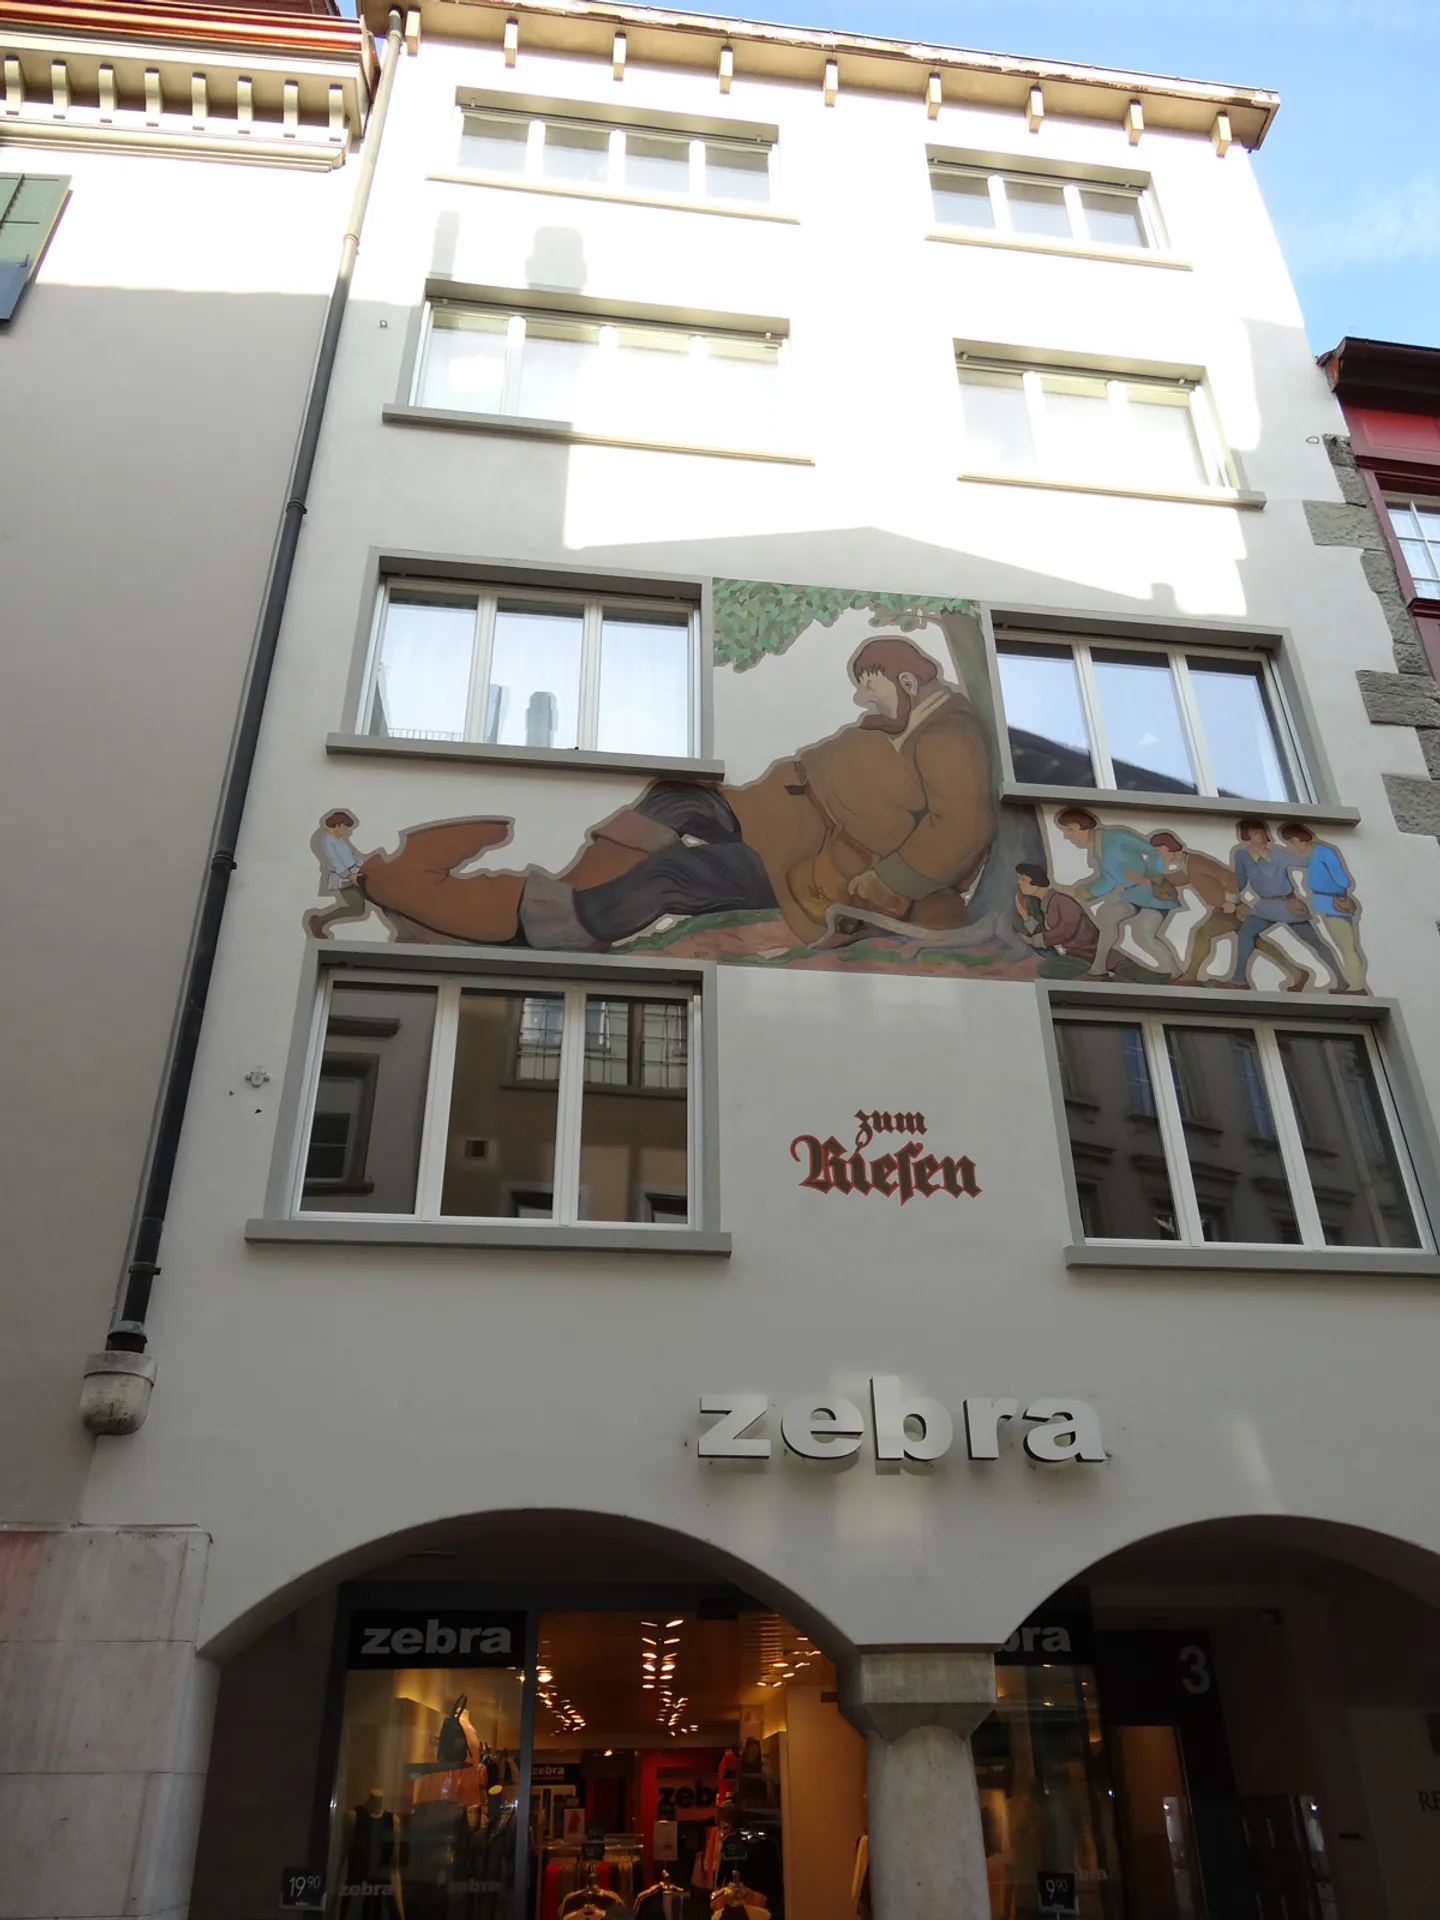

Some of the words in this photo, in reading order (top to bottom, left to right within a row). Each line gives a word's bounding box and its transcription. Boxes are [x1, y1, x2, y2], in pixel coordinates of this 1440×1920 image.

[854, 1109, 928, 1149] zum
[698, 1375, 1106, 1463] zebra
[361, 1618, 511, 1655] zebra
[1179, 1645, 1211, 1695] 3
[338, 1880, 394, 1897] zebra
